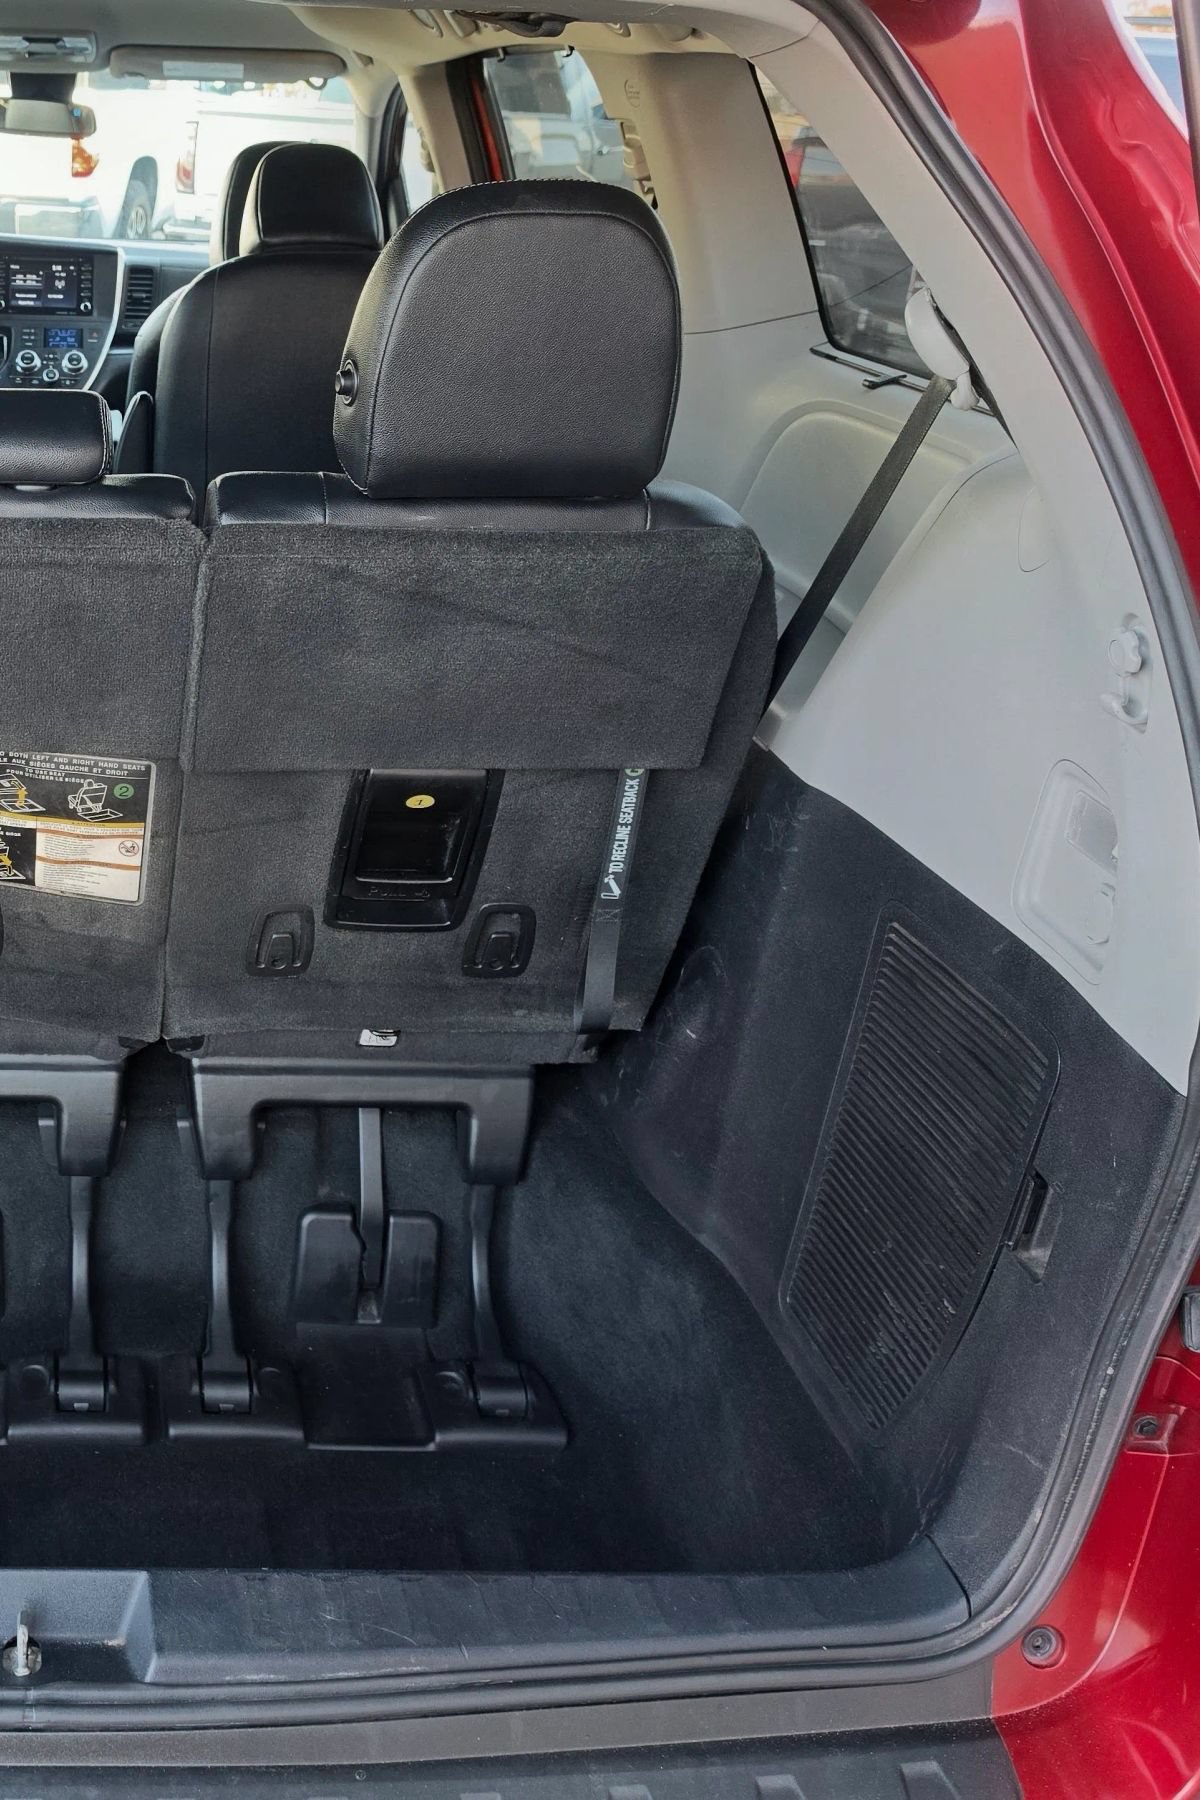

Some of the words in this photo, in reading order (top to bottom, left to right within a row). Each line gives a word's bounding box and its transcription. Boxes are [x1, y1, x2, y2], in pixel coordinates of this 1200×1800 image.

[59, 764, 89, 772] GAUCHE
[25, 772, 54, 780] UTILISER
[119, 786, 129, 797] 2
[619, 779, 640, 824] SEATBACK
[611, 825, 631, 861] RECLINE
[609, 862, 624, 873] TO
